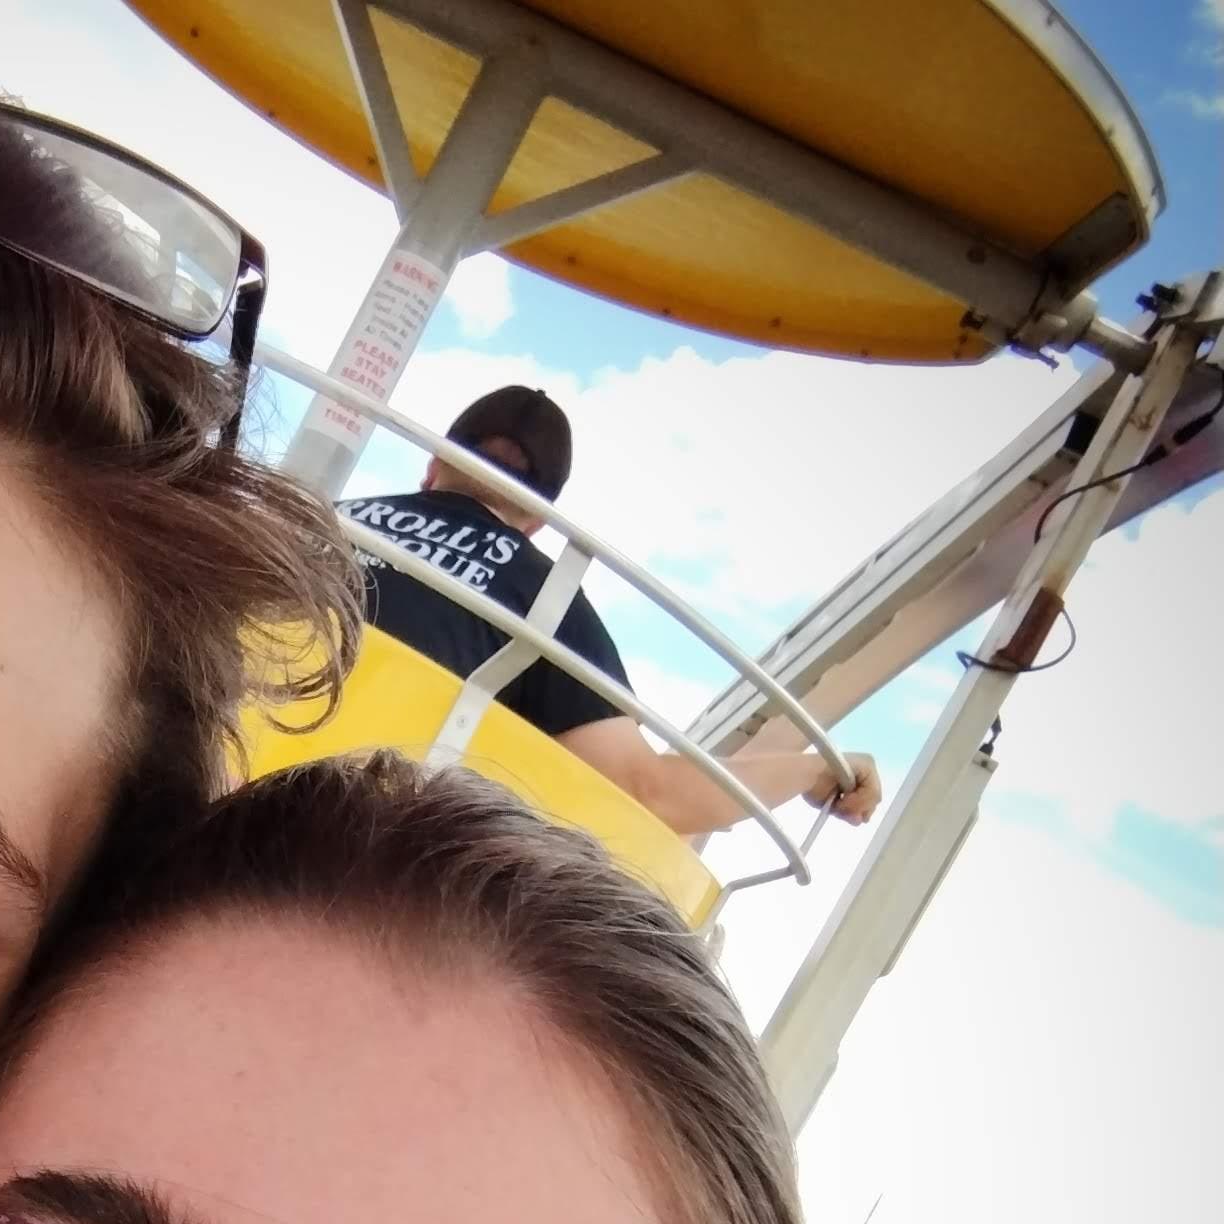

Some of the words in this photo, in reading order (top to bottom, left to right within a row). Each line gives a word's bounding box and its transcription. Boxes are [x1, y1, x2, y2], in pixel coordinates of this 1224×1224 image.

[353, 339, 400, 371] PLEASE
[355, 356, 387, 379] STAY
[341, 366, 386, 399] SEATED
